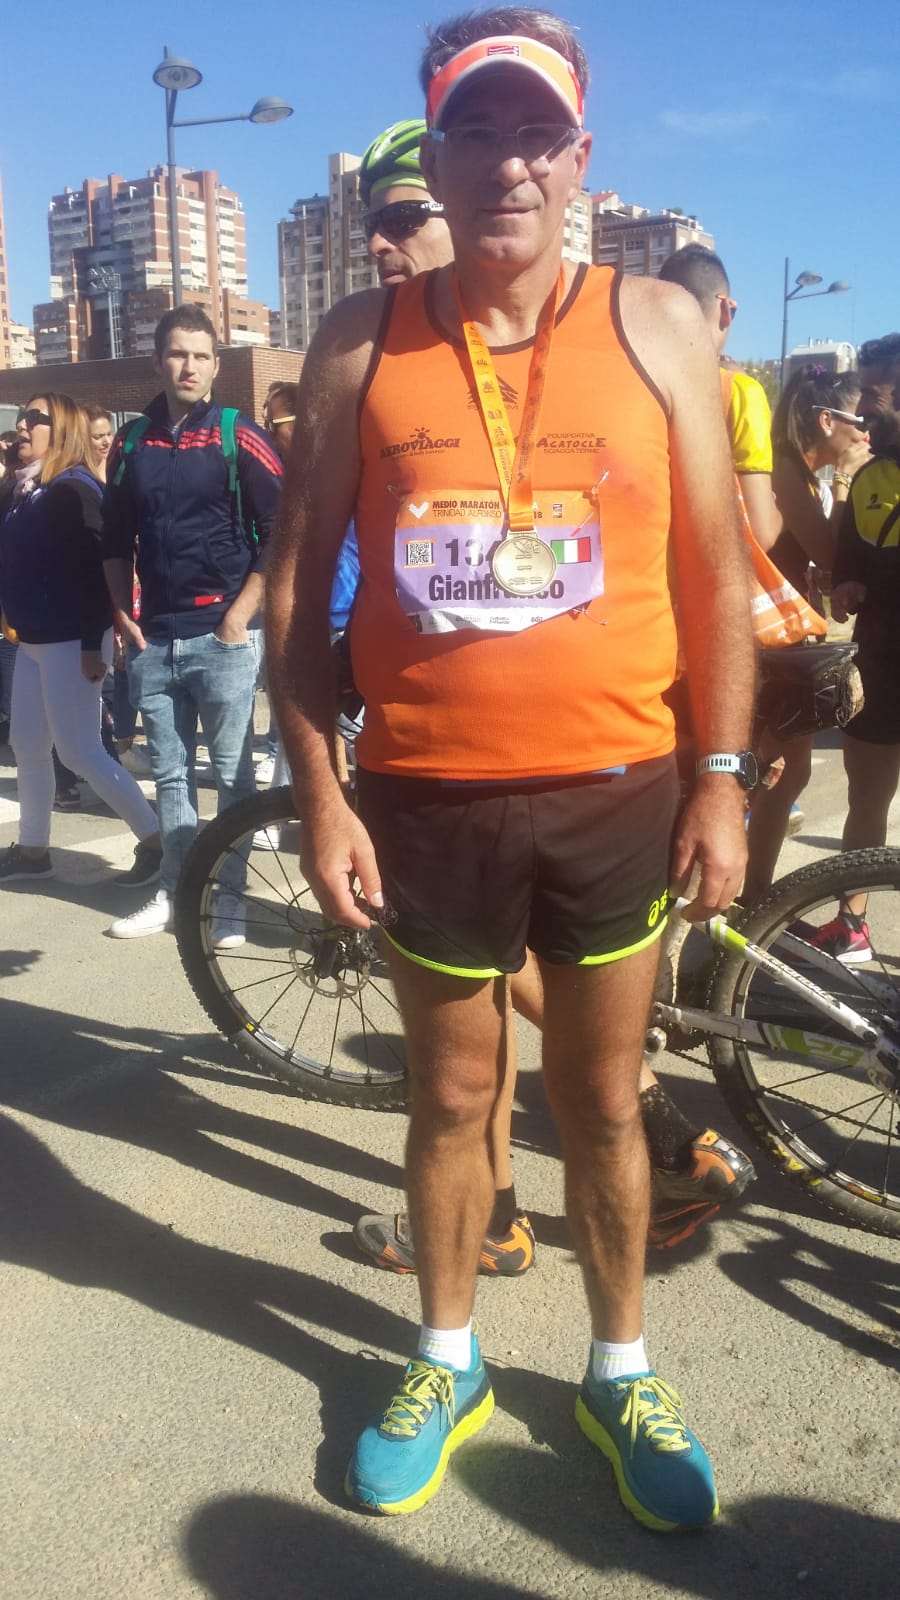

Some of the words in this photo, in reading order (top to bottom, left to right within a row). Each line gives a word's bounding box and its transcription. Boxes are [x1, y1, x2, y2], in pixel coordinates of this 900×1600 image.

[432, 500, 457, 509] MEDIO
[432, 509, 465, 518] TRINIDAD
[467, 509, 502, 518] ALFONSO
